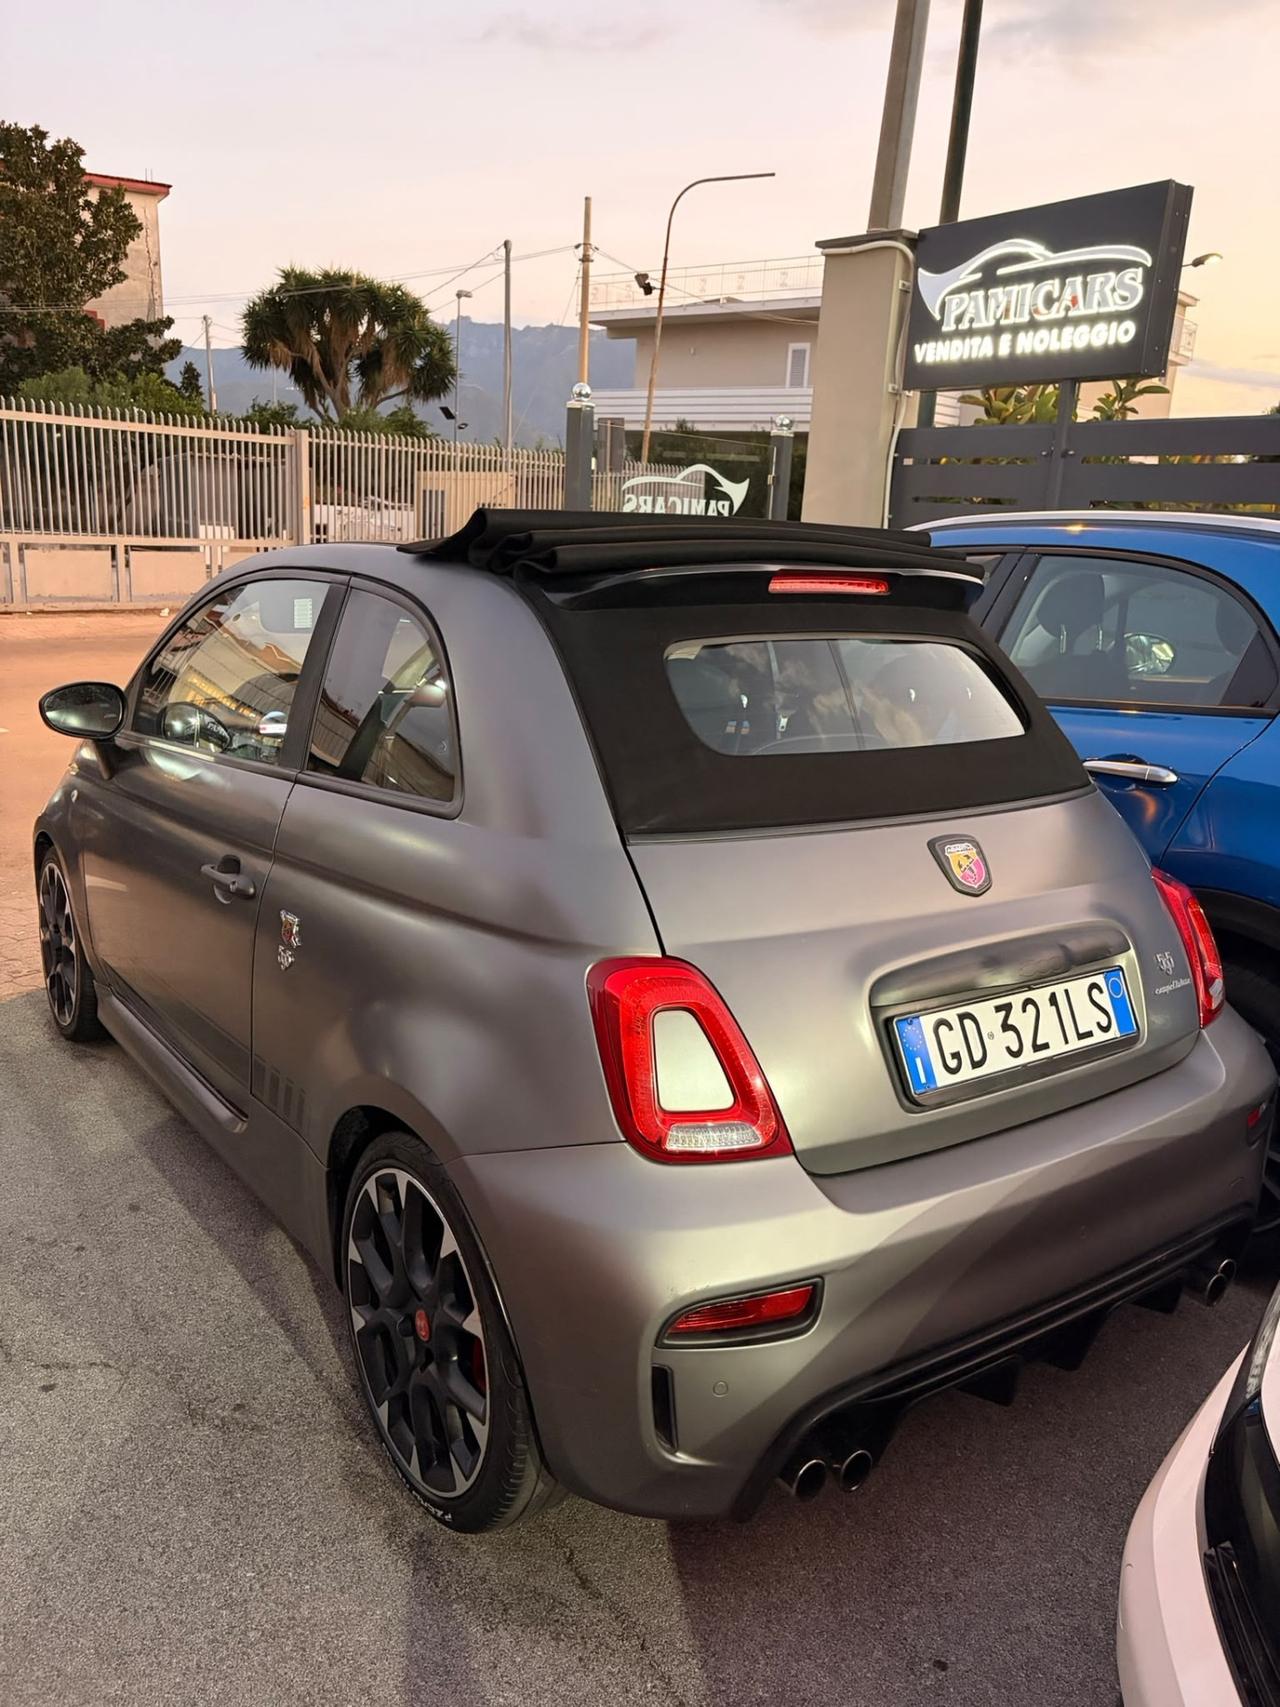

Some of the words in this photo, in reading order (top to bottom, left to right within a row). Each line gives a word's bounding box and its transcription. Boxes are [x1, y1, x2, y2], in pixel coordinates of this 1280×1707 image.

[941, 268, 1144, 332] PAMICARS
[914, 337, 993, 364] VENDITA
[999, 333, 1012, 356] E
[1016, 320, 1136, 354] NOLEGGIO
